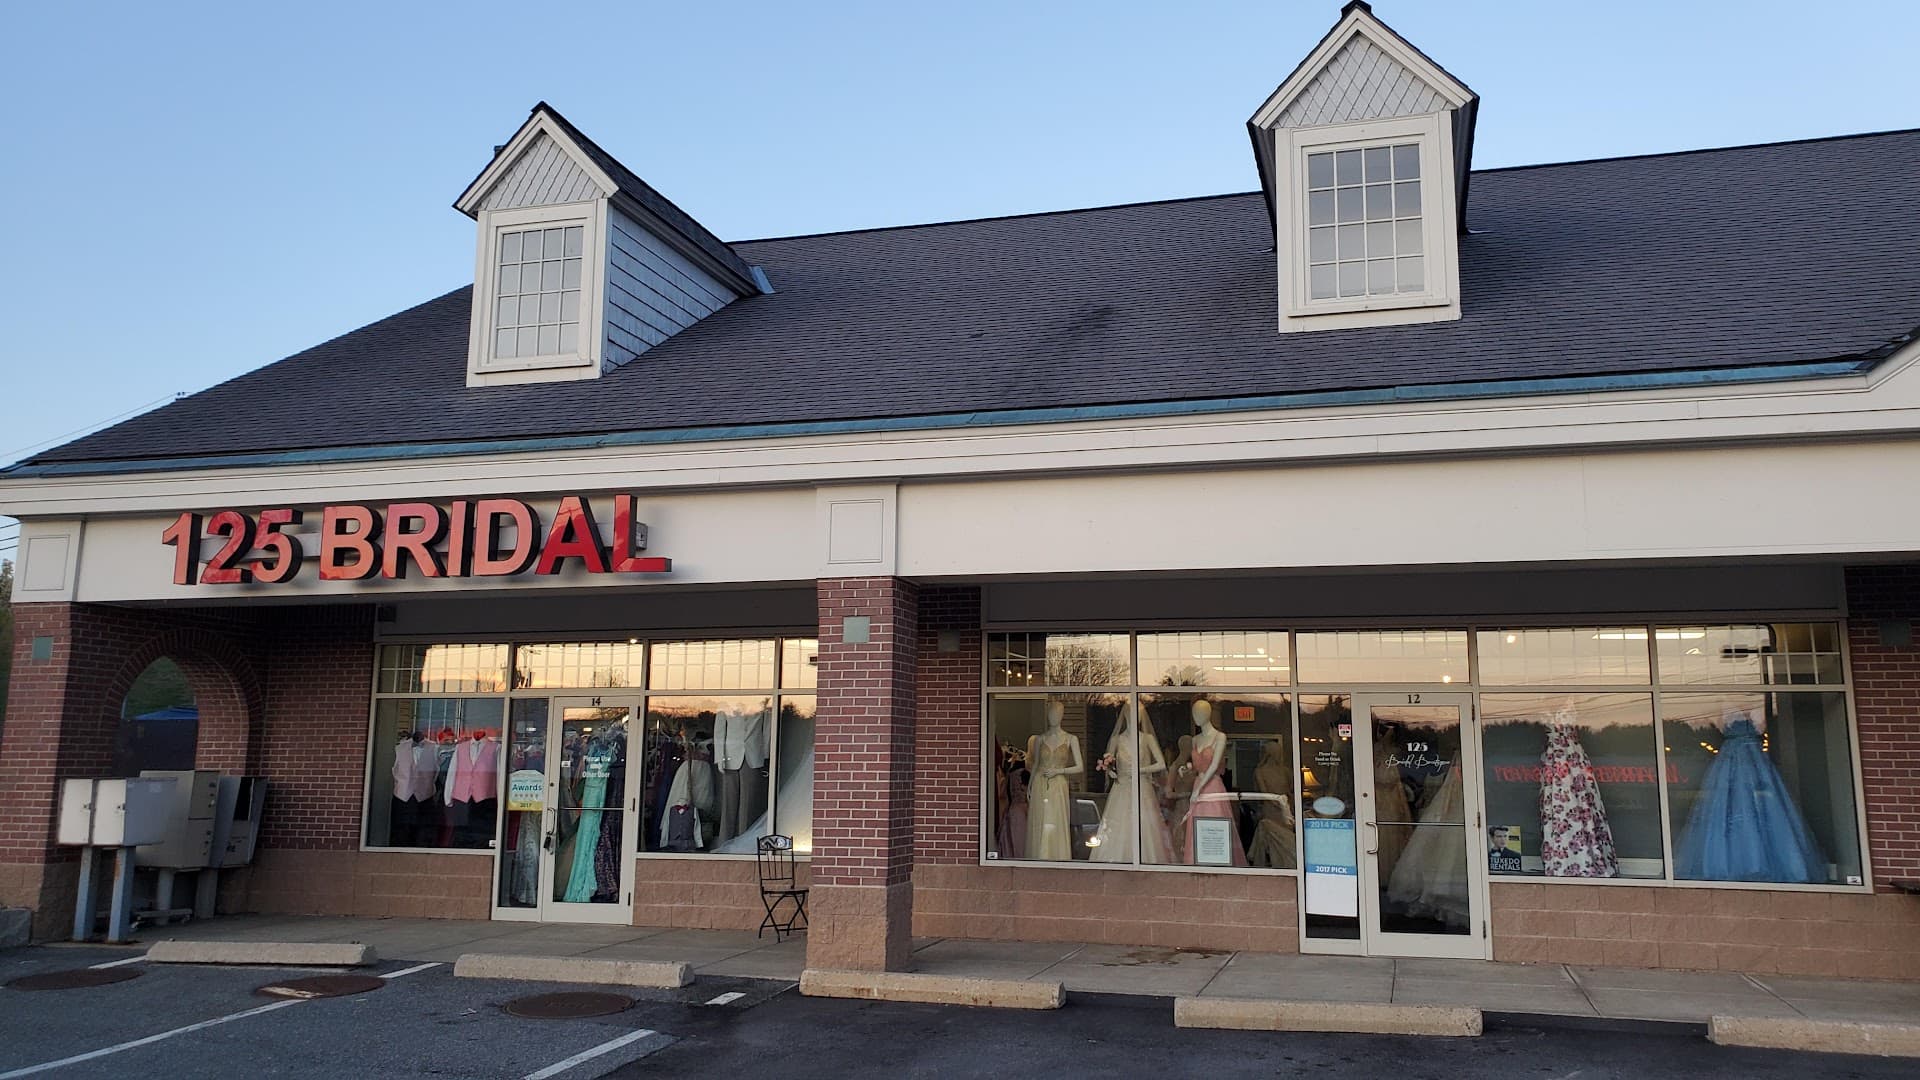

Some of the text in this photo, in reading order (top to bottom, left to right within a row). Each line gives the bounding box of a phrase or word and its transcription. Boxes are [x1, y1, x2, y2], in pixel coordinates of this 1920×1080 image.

[161, 494, 672, 586] 125 BRIDAL
[591, 695, 602, 706] 14
[1407, 694, 1421, 704] 12
[1407, 742, 1428, 752] 125
[1490, 857, 1520, 865] TUXEDO
[1315, 865, 1330, 873] 2017
